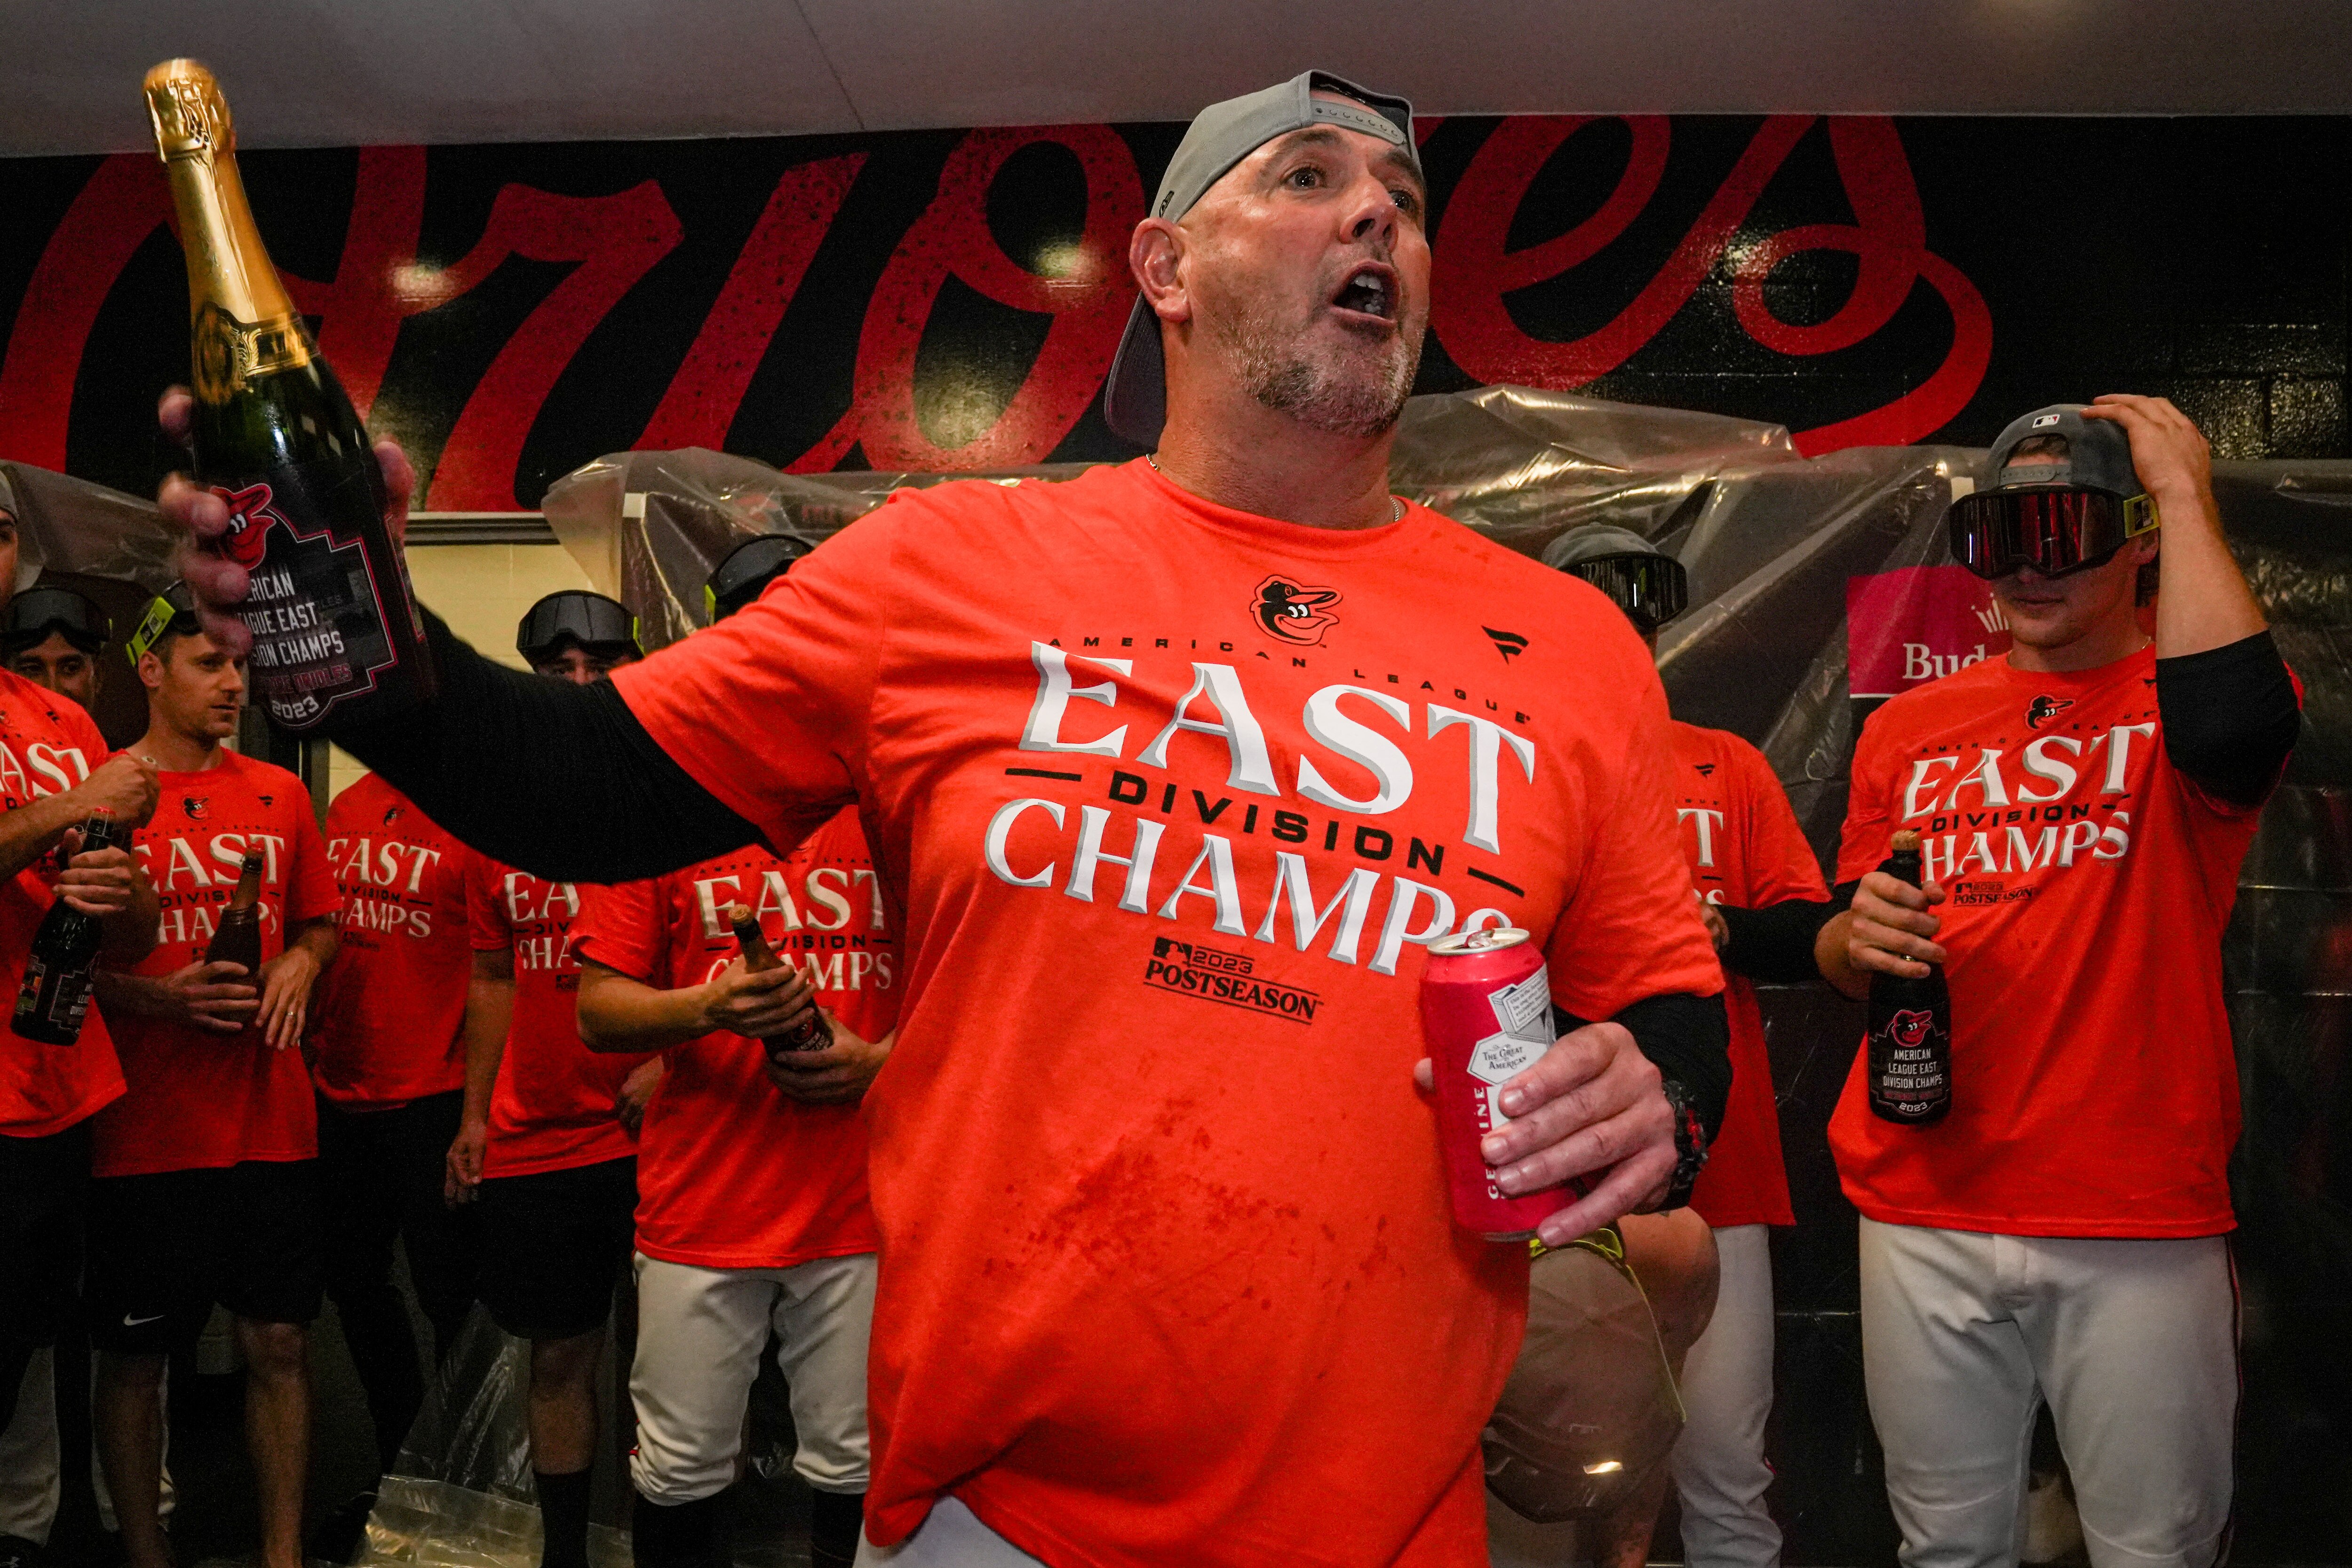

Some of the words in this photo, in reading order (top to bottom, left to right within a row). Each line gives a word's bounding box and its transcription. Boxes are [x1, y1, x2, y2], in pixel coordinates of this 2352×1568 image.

[0, 115, 1993, 513] Orioes
[276, 602, 318, 632] EAST
[278, 630, 345, 666] CHAMPS
[1048, 637, 1306, 668] AMERICAN
[1902, 643, 1998, 679] Bud
[271, 695, 319, 719] 2023
[1353, 669, 1526, 724] LEAGUE
[1018, 640, 1535, 855] EAST
[0, 740, 90, 800] AST
[1901, 721, 2156, 825] EAST
[1108, 771, 1445, 876] DIVISION
[1931, 803, 2090, 833] DIVISION
[1922, 811, 2130, 883] HAMPS
[504, 872, 580, 923] EA
[1192, 951, 1253, 974] 2023
[1144, 958, 1318, 1020] POSTSEASON
[1888, 1062, 1918, 1075] LEAGUE
[1920, 1061, 1937, 1075] EAST
[1894, 1048, 1931, 1060] AMERICAN
[1883, 1075, 1914, 1089] DIVISION
[1915, 1074, 1942, 1089] CHAMPS
[1899, 1101, 1928, 1112] 2023
[1474, 1087, 1500, 1200] GEINE
